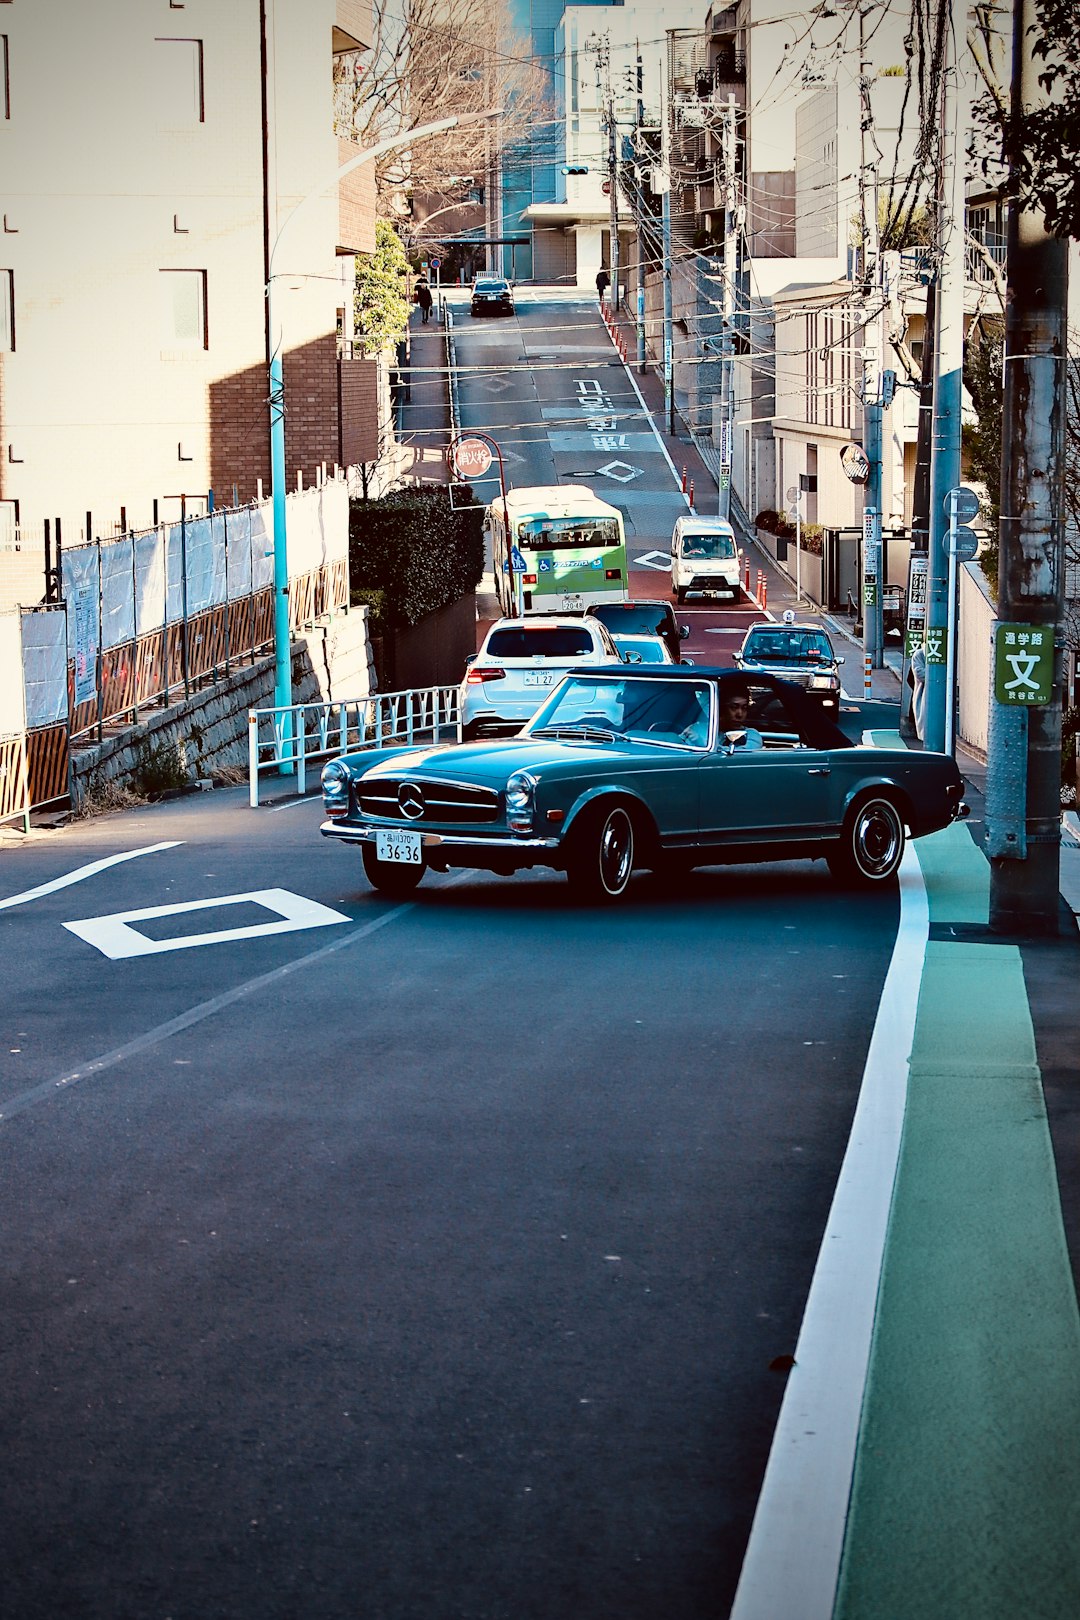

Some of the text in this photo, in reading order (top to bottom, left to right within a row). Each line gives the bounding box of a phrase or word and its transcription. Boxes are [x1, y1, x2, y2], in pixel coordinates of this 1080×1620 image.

[458, 449, 488, 466] 消火栓
[864, 591, 874, 603] 文
[1004, 631, 1043, 645] 通学路
[927, 637, 942, 657] 文
[1004, 649, 1041, 690] 文
[1008, 690, 1035, 700] 渋谷区
[387, 844, 419, 862] 36-36
